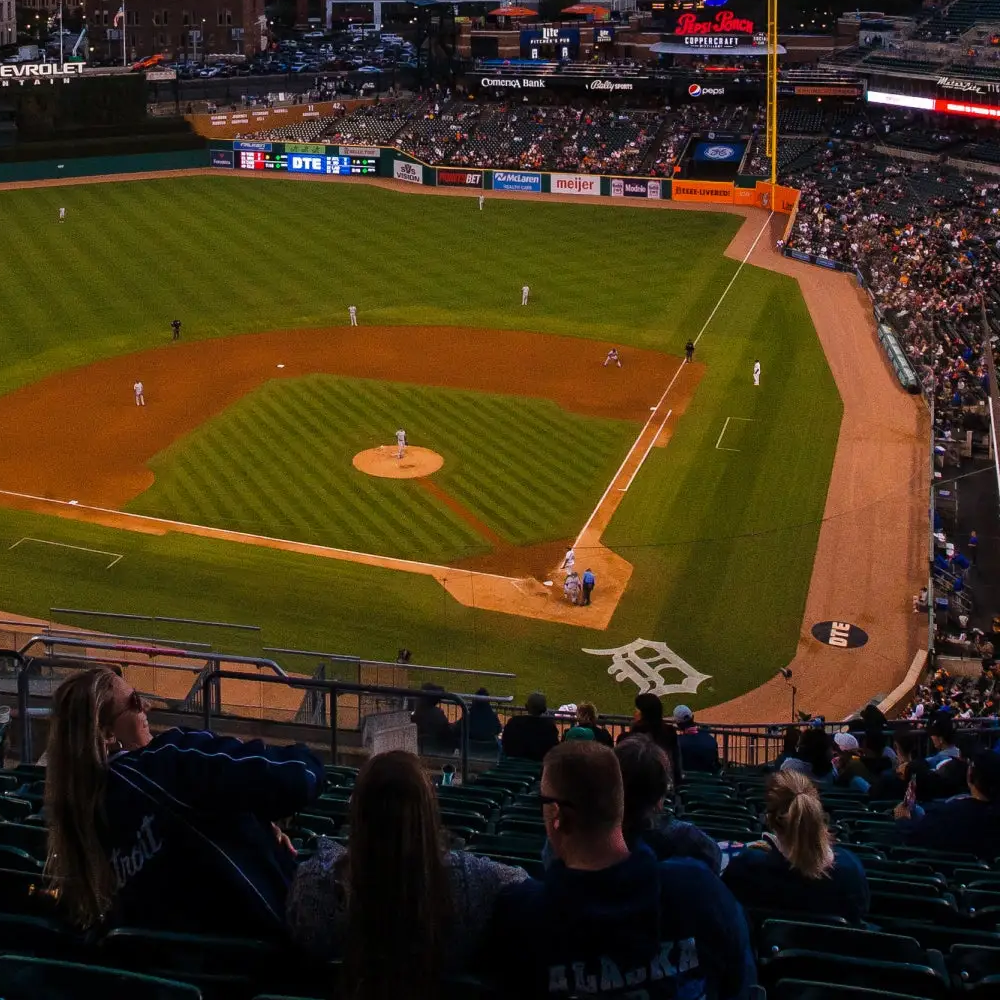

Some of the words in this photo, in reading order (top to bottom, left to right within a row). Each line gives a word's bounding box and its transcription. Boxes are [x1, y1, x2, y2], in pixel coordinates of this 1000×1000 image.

[542, 27, 559, 41] Lite
[684, 37, 739, 45] COPPERCRAFT
[523, 79, 546, 88] Bank
[590, 80, 615, 92] Bally
[702, 87, 725, 95] pepsi
[292, 157, 322, 170] DTE
[396, 171, 421, 183] VISION
[506, 174, 539, 183] McLaren
[556, 177, 595, 193] meijer
[625, 184, 646, 193] Modelo
[829, 621, 851, 647] DTE
